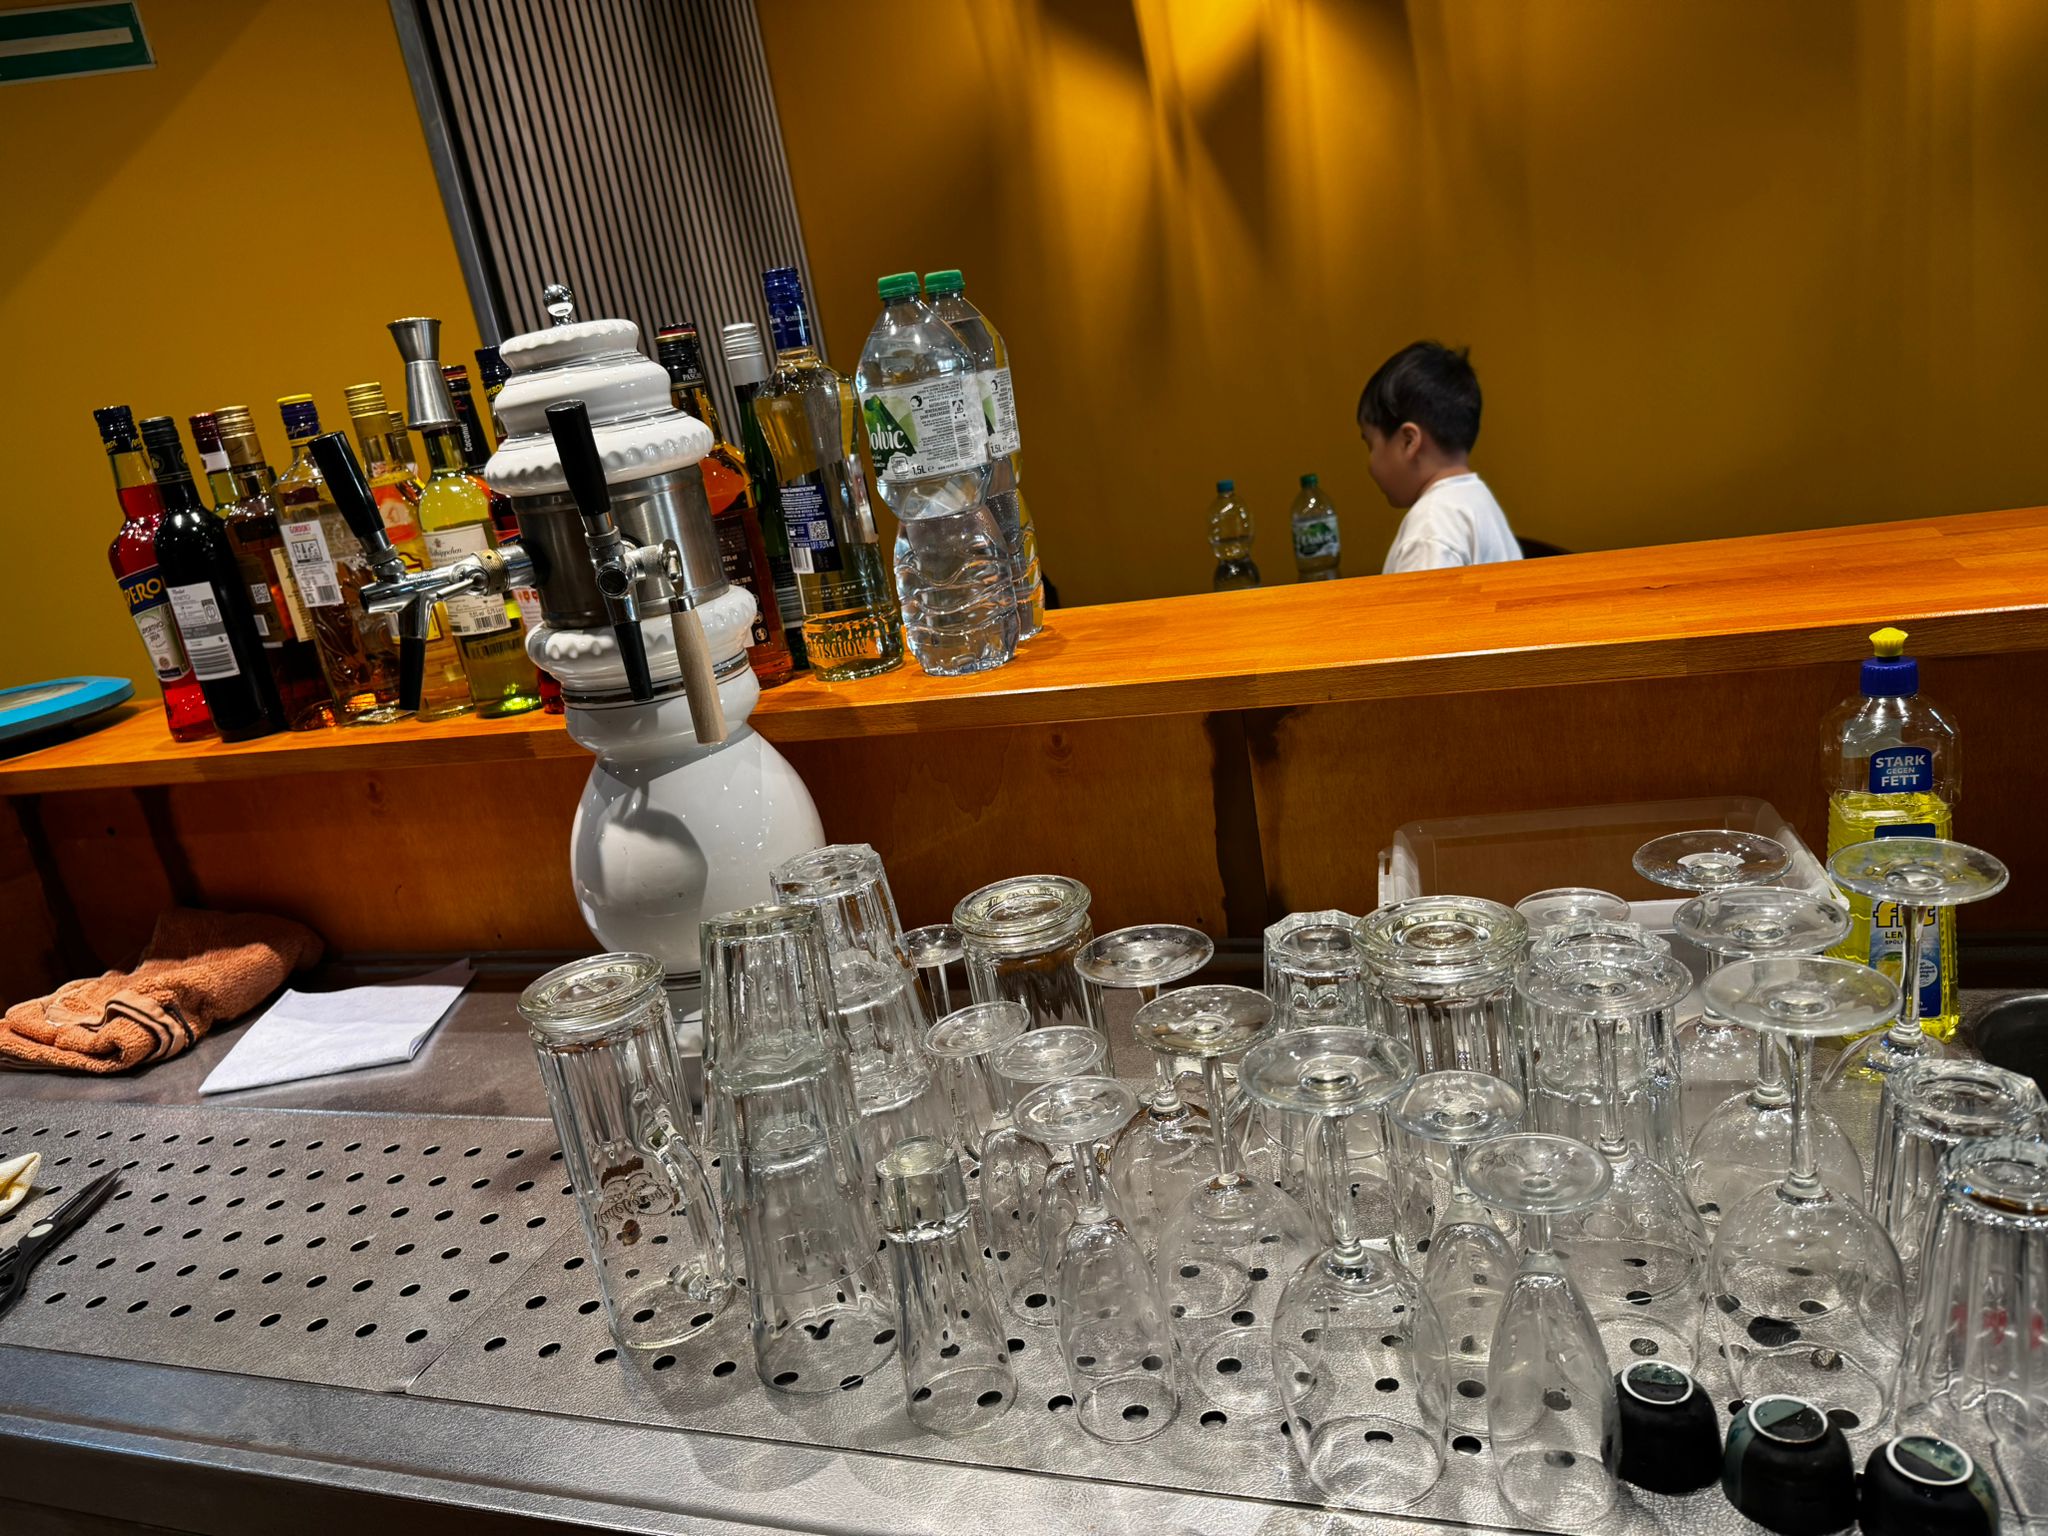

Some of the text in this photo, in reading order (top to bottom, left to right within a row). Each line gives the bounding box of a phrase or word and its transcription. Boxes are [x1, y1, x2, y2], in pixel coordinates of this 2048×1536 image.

[124, 577, 162, 606] PERO
[1875, 755, 1926, 768] STARK
[1886, 767, 1915, 775] GEGEN
[1881, 774, 1920, 787] FETT
